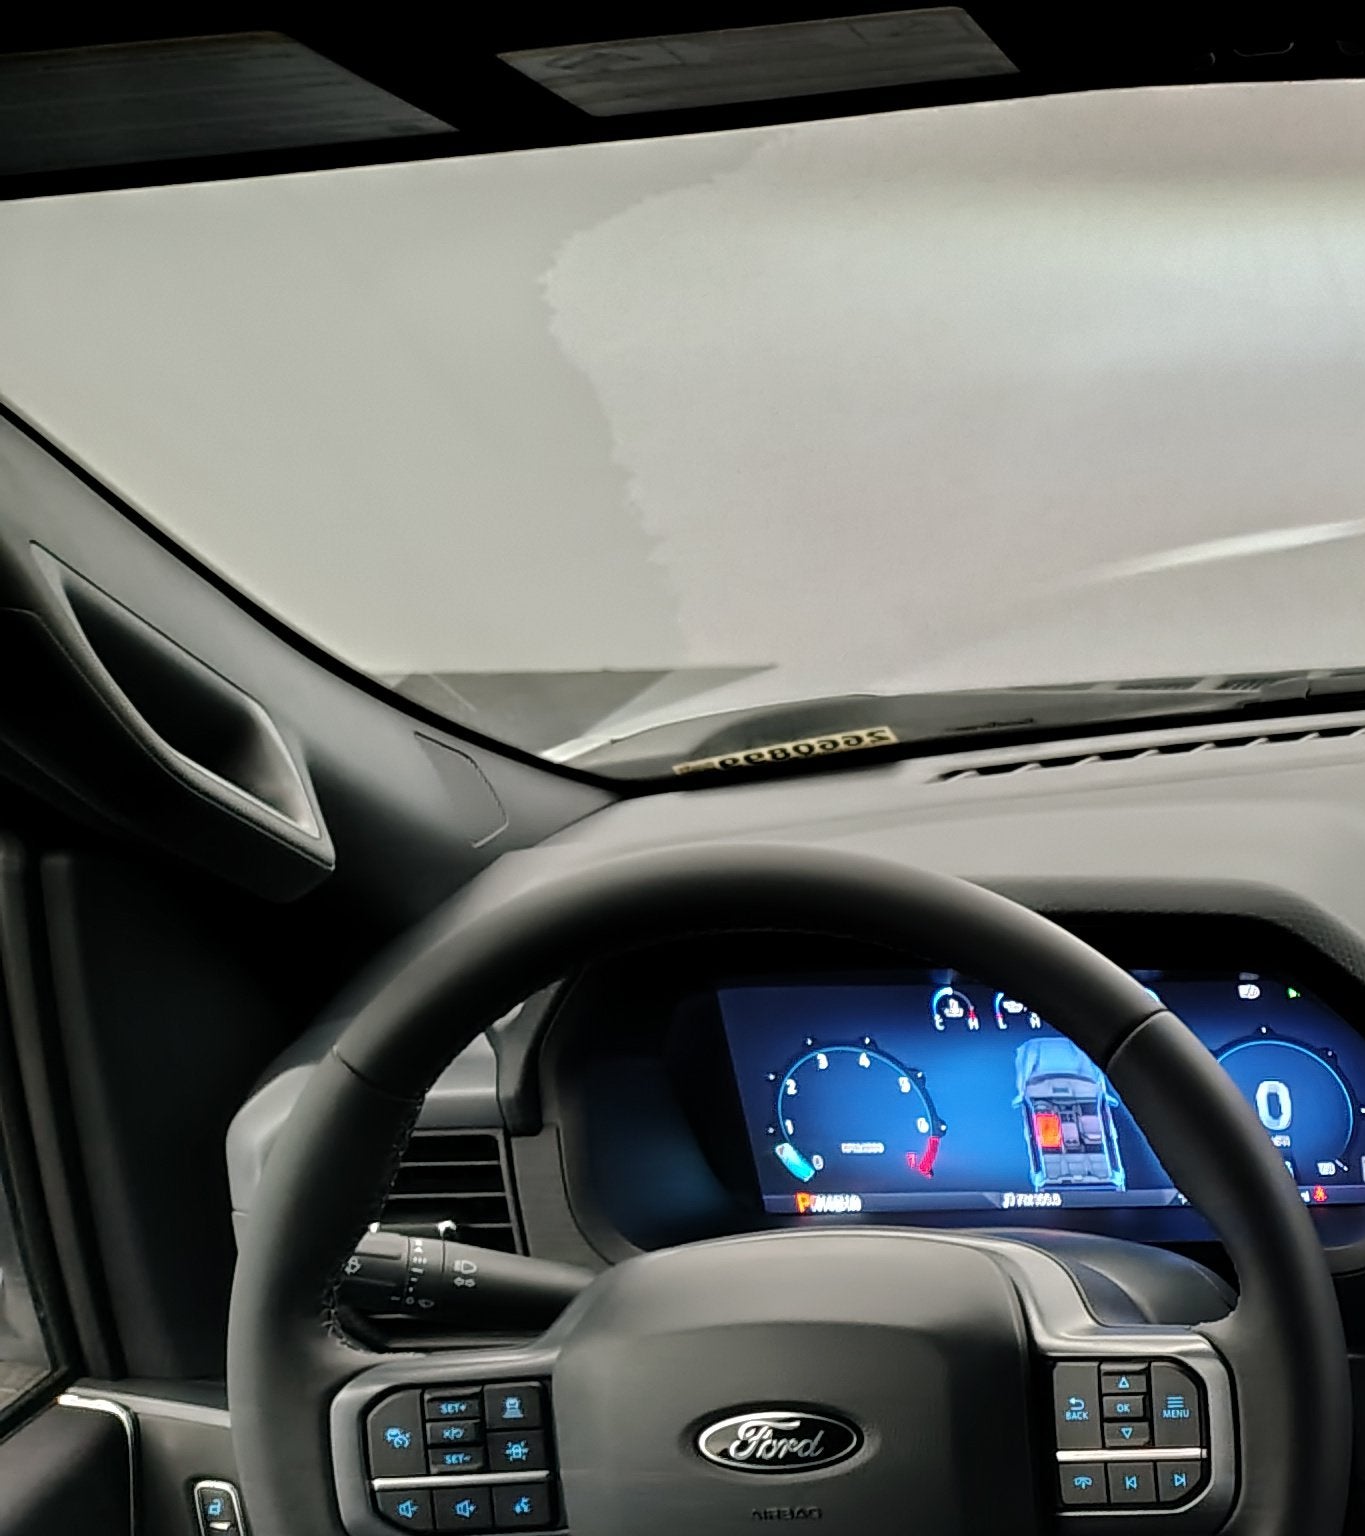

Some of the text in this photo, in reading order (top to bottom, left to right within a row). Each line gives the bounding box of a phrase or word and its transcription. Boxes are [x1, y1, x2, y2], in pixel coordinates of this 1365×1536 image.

[817, 1053, 829, 1070] 3
[786, 1078, 798, 1095] 2
[1255, 1080, 1292, 1131] 0
[785, 1119, 795, 1135] 1
[1065, 1411, 1089, 1421] BACK
[1116, 1404, 1131, 1413] OK
[1162, 1409, 1190, 1419] MENU
[729, 1420, 825, 1461] Ford
